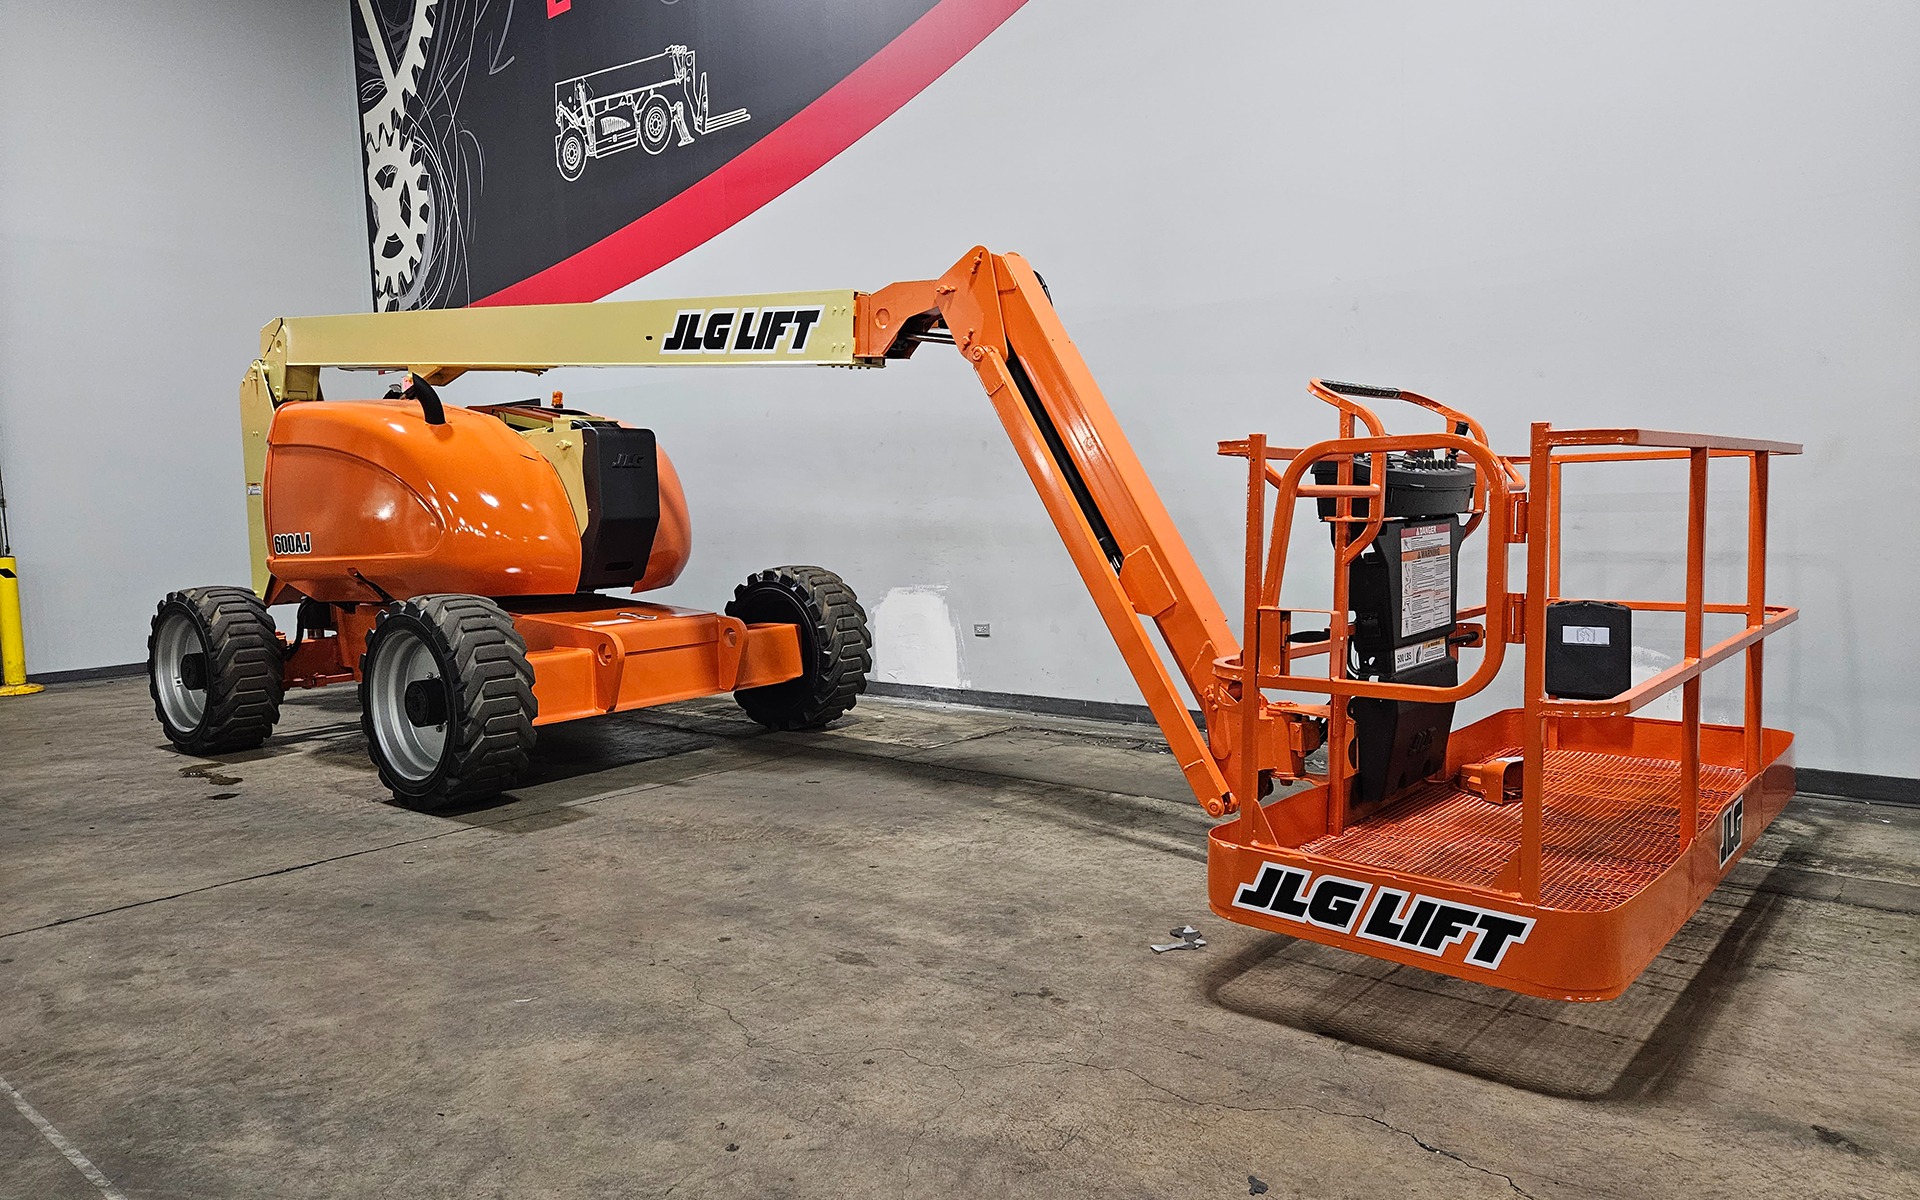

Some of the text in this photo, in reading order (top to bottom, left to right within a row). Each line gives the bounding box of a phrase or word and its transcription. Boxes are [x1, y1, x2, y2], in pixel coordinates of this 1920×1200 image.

[661, 308, 822, 352] JLG LIFT
[611, 452, 645, 468] JLG
[274, 533, 311, 553] 600AJ
[1720, 797, 1743, 865] JLG
[1235, 864, 1531, 966] JLG LIFT
